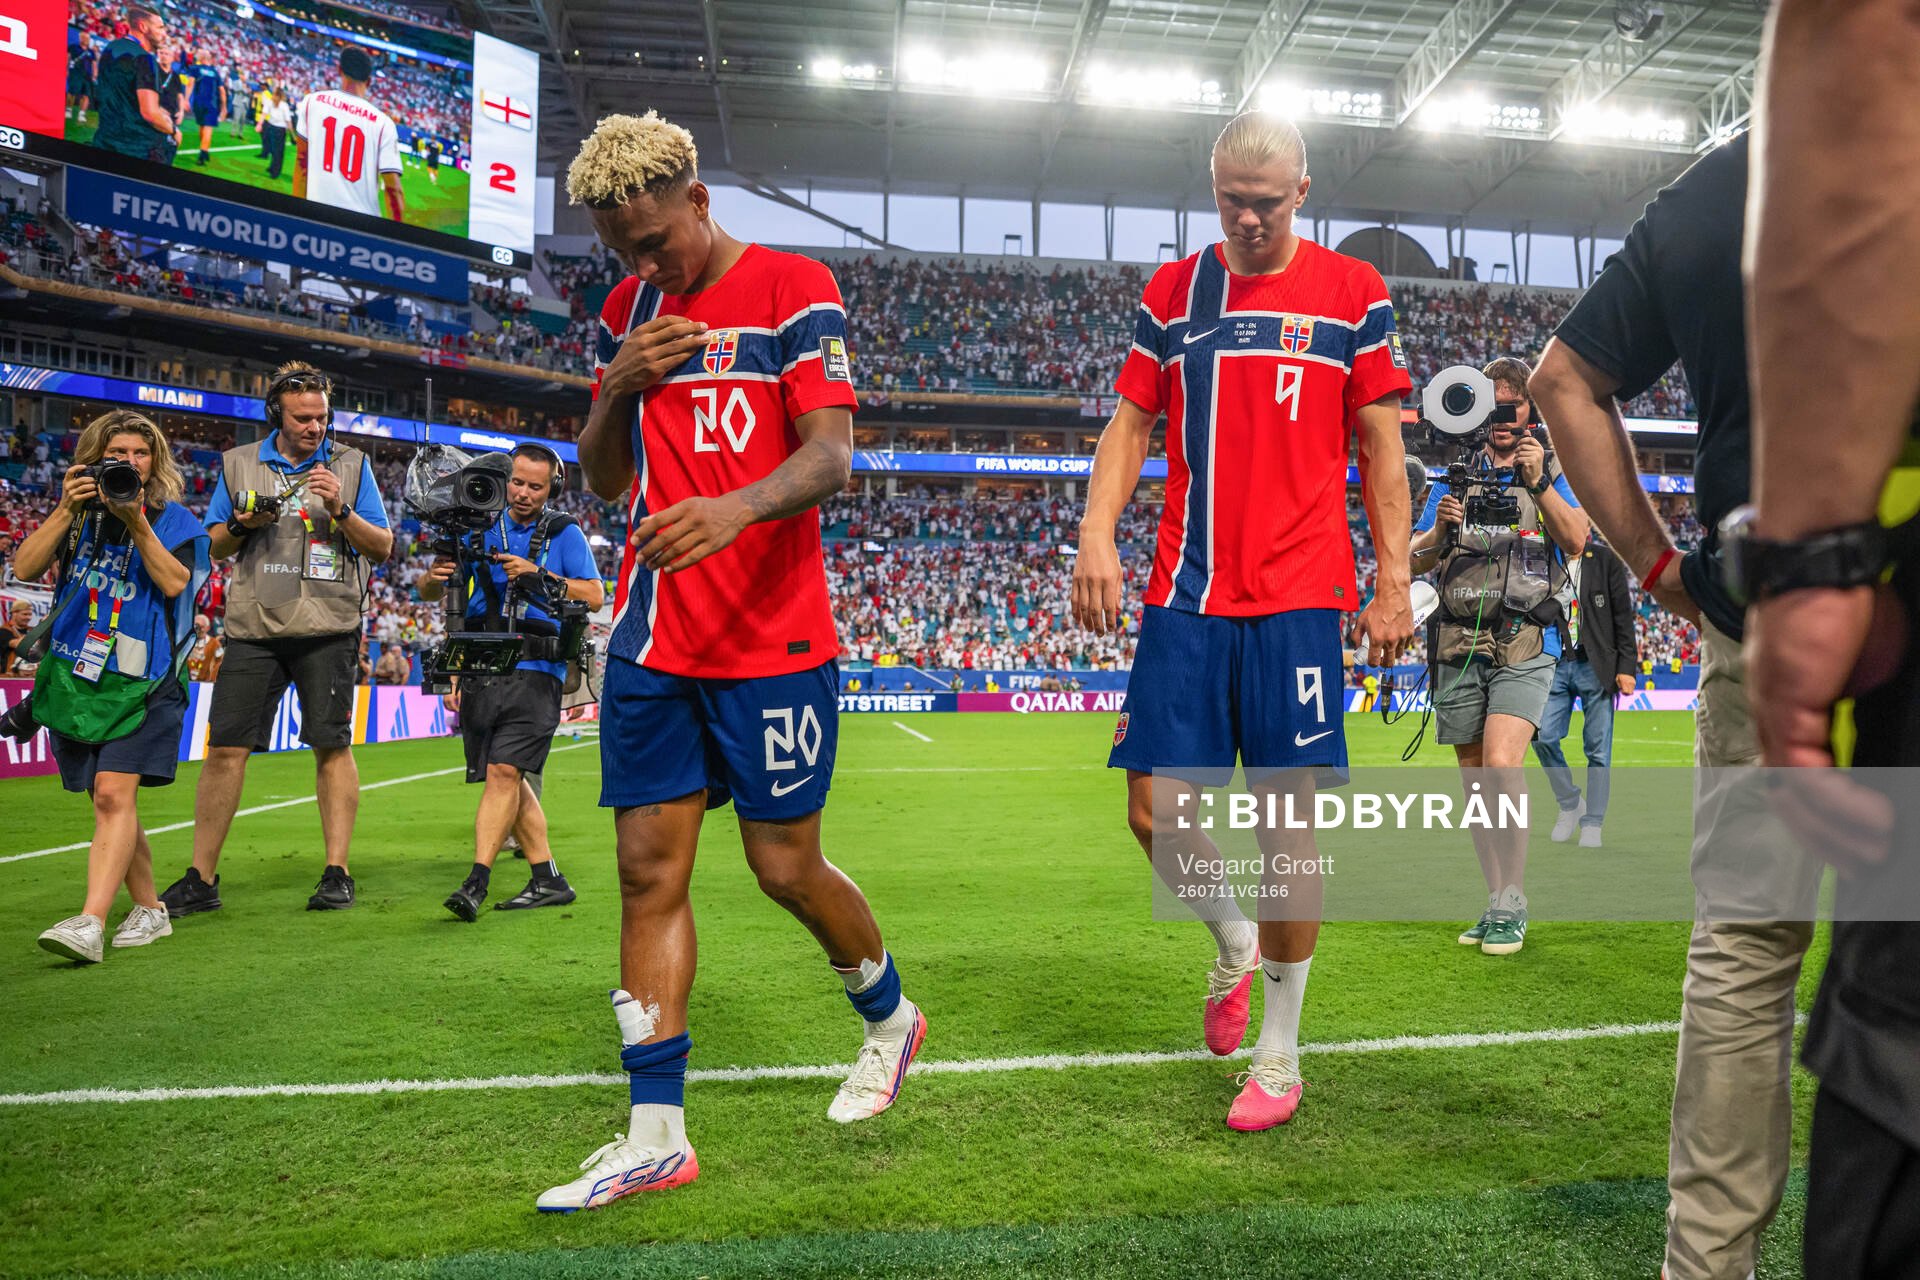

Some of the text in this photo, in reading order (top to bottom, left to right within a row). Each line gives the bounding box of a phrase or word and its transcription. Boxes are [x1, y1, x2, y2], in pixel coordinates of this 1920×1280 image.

[0, 130, 21, 146] CC
[323, 116, 365, 183] 10
[489, 162, 516, 193] 2
[112, 191, 437, 283] FIFA WORLD CUP 2026
[495, 249, 510, 263] CC
[138, 386, 203, 408] MIAMI
[1275, 364, 1304, 421] 9
[692, 388, 756, 453] 20
[976, 457, 1007, 470] FIFA
[1007, 458, 1059, 472] WORLD
[1060, 460, 1089, 472] CUP
[77, 541, 125, 572] FFA
[263, 564, 302, 573] FIFA.c
[66, 563, 137, 601] HOTO
[1453, 587, 1501, 600] FIFA.com
[1009, 675, 1042, 688] FIFA
[1296, 667, 1325, 722] 9
[1010, 692, 1085, 713] QATAR
[762, 705, 822, 771] 20
[584, 1151, 687, 1208] F50
